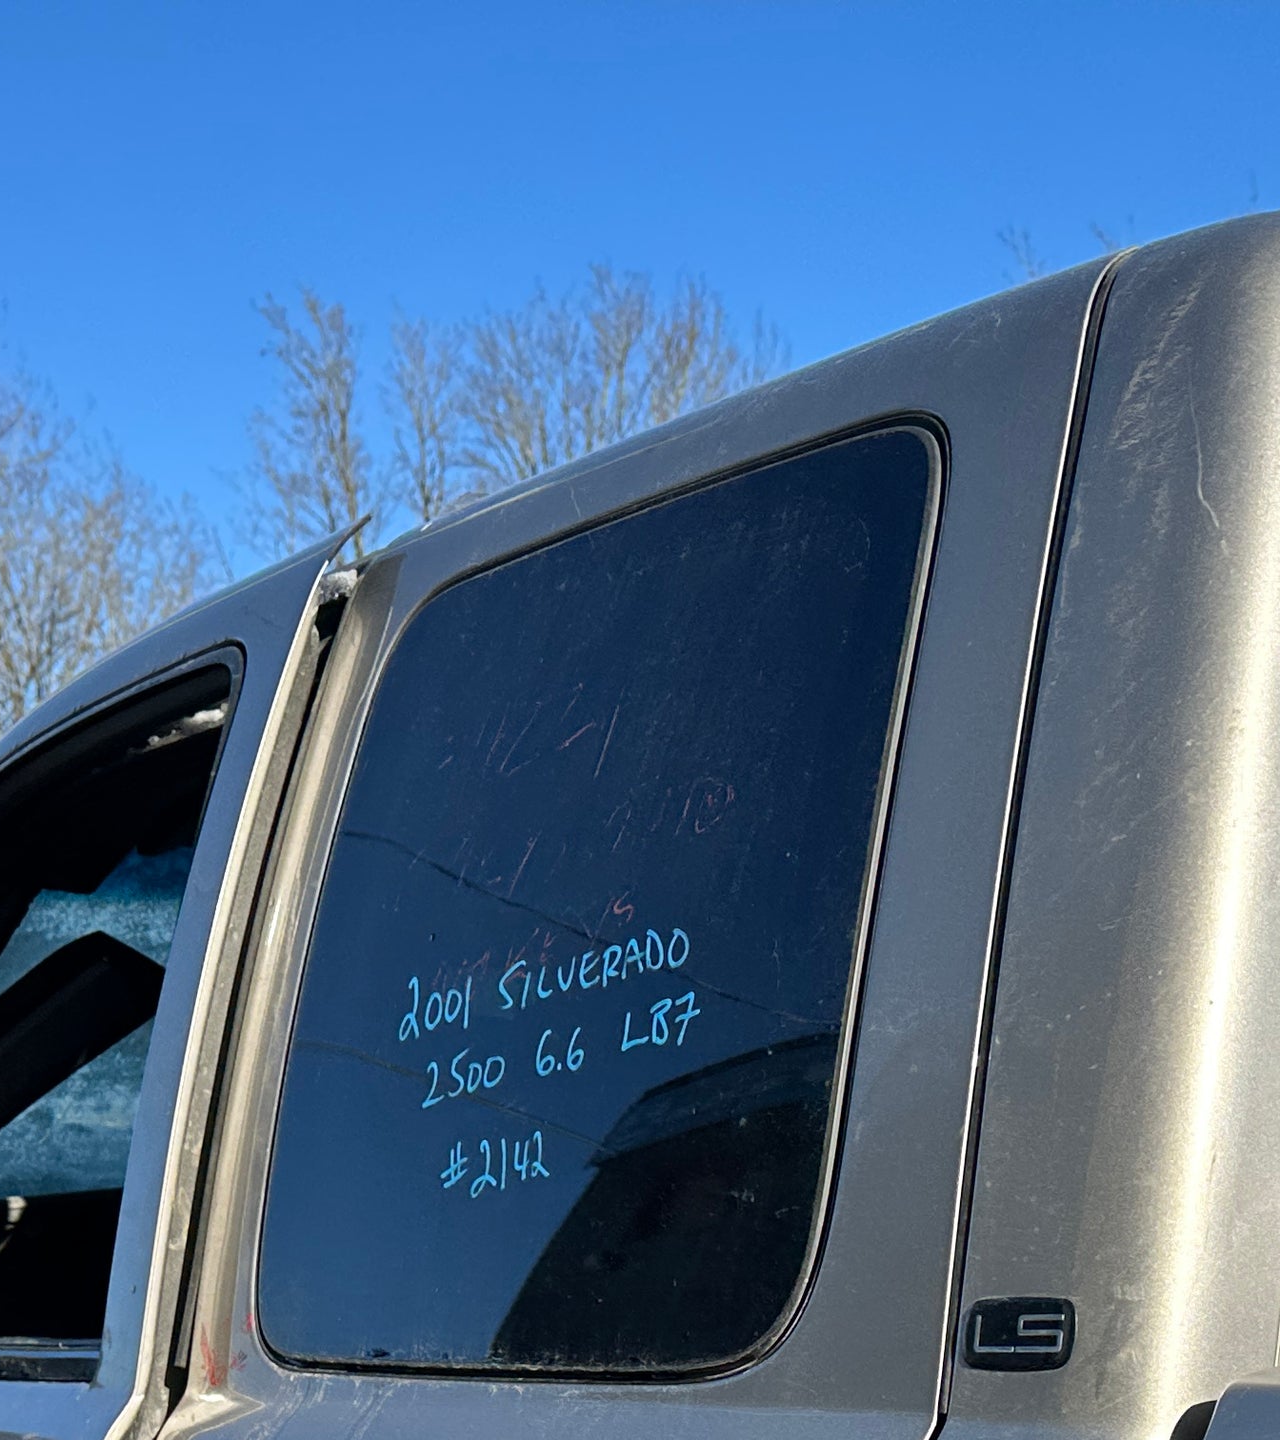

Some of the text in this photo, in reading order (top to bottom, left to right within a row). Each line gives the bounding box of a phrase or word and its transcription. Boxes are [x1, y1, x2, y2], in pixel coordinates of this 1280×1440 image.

[398, 976, 472, 1041] 2001
[498, 928, 690, 1010] SILVERADO
[422, 991, 701, 1109] 2500 6.6 LB7
[440, 1130, 550, 1199] #2142
[973, 1313, 1065, 1353] LS
